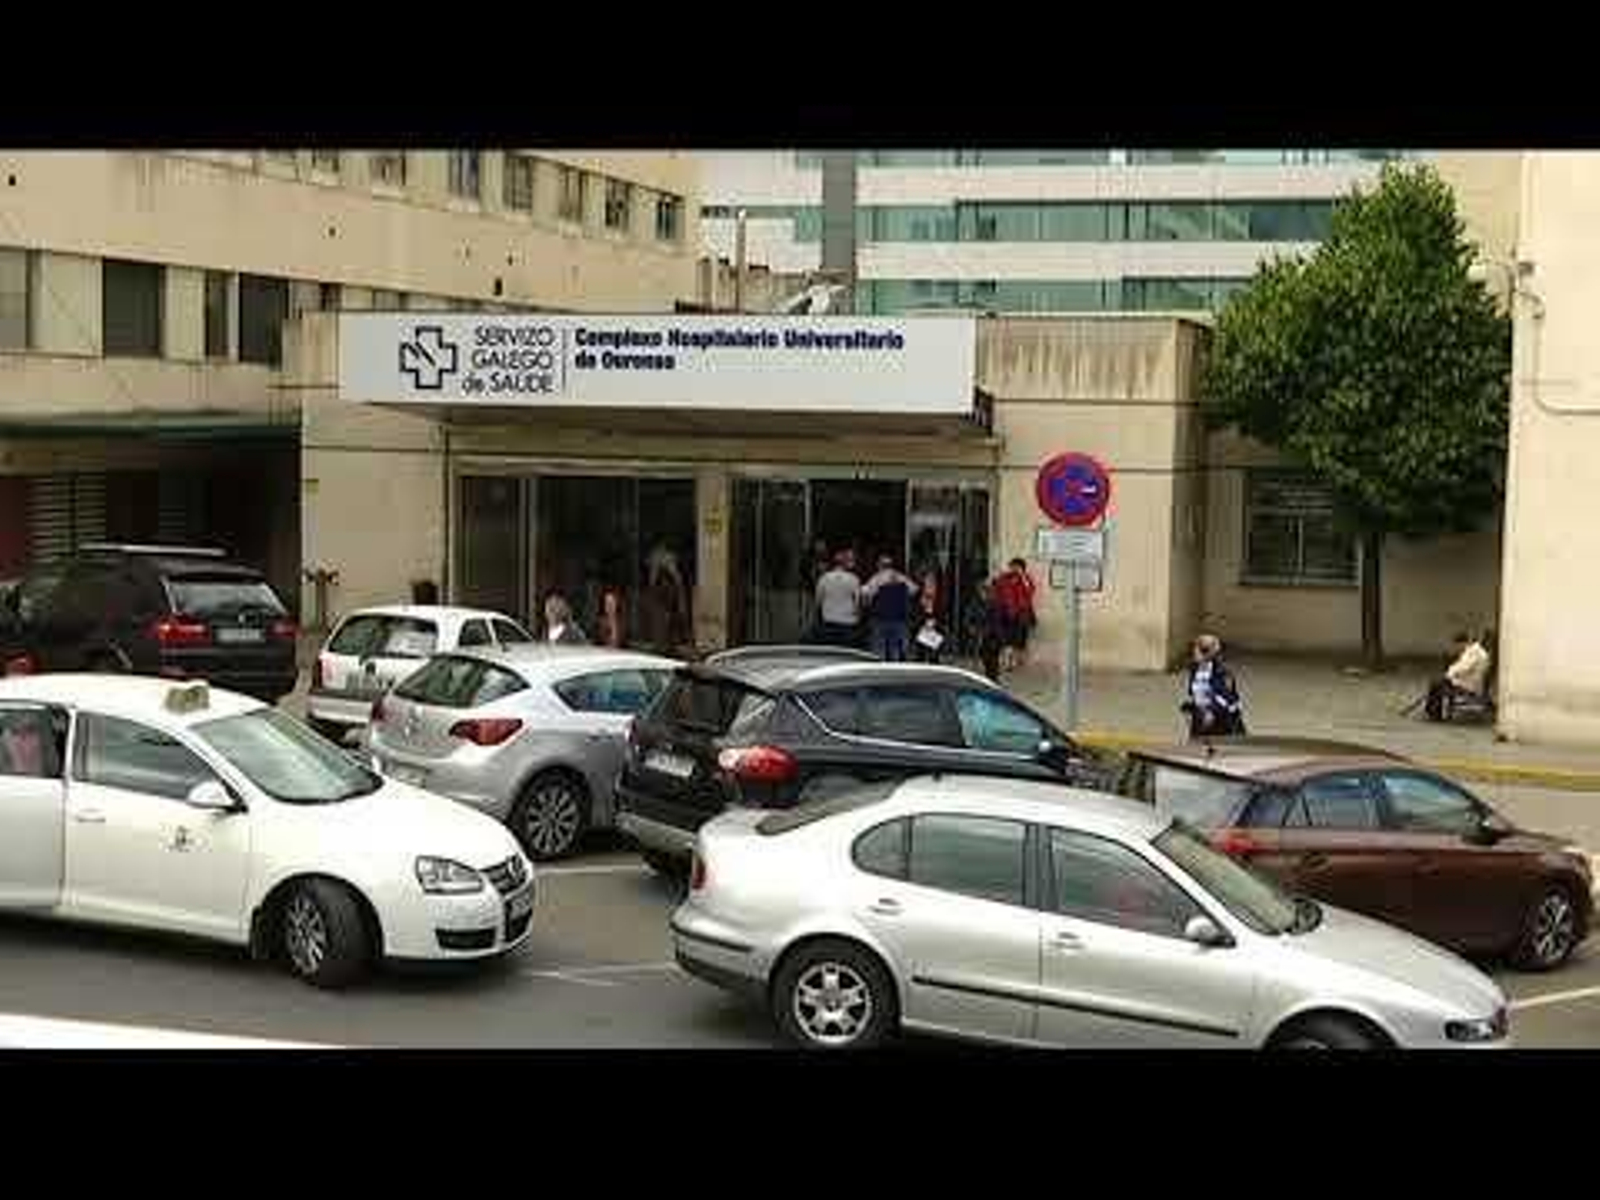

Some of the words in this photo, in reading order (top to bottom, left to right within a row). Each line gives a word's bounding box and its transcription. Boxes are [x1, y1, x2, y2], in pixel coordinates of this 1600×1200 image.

[474, 326, 553, 347] SERVIZO
[574, 328, 663, 350] Complexo
[668, 329, 780, 351] Hospitalario
[784, 330, 905, 350] Universitario
[471, 349, 554, 370] GALEGO
[574, 351, 597, 370] de
[602, 351, 676, 370] Ourense
[461, 374, 485, 394] de
